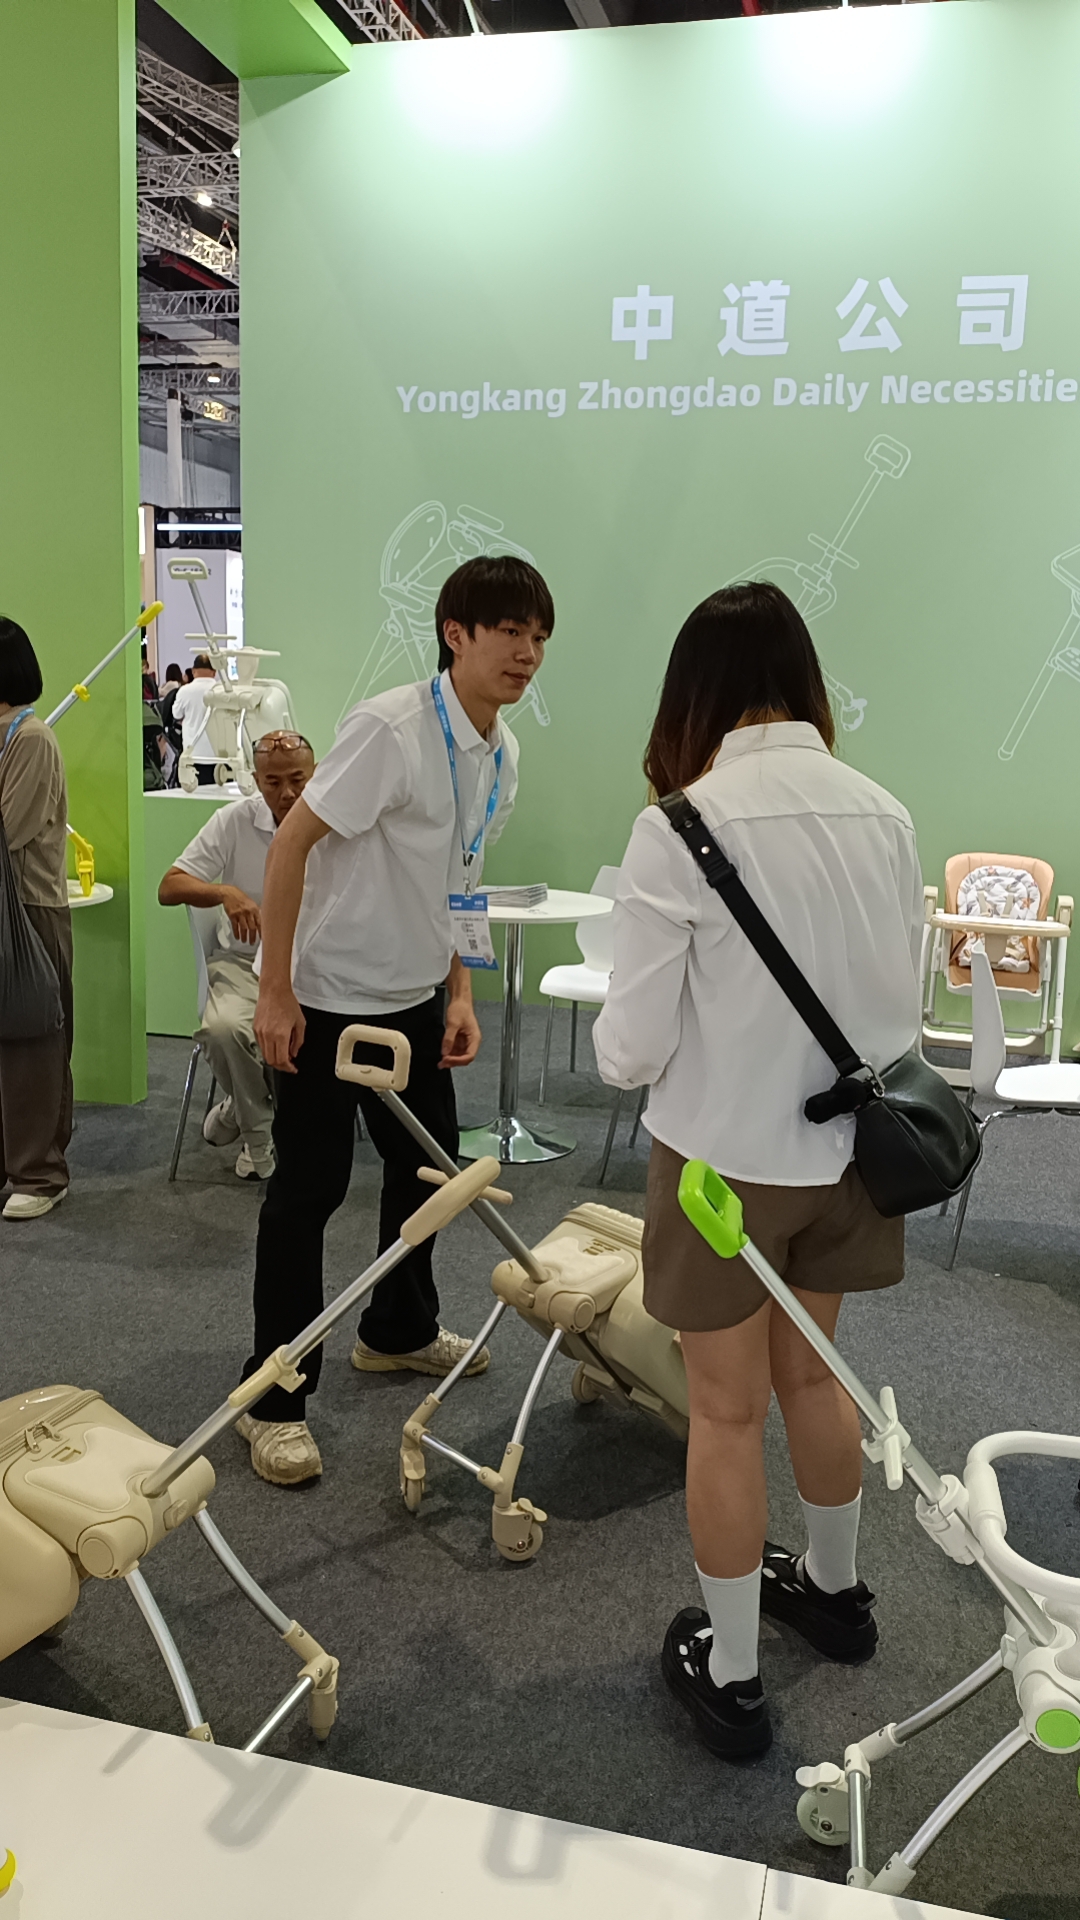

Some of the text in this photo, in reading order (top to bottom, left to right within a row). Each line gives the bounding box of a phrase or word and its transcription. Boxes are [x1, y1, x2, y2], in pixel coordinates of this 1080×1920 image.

[611, 275, 1029, 360] 中道公司
[396, 369, 1078, 420] Yongkang Zhongdao Daily Necessitie
